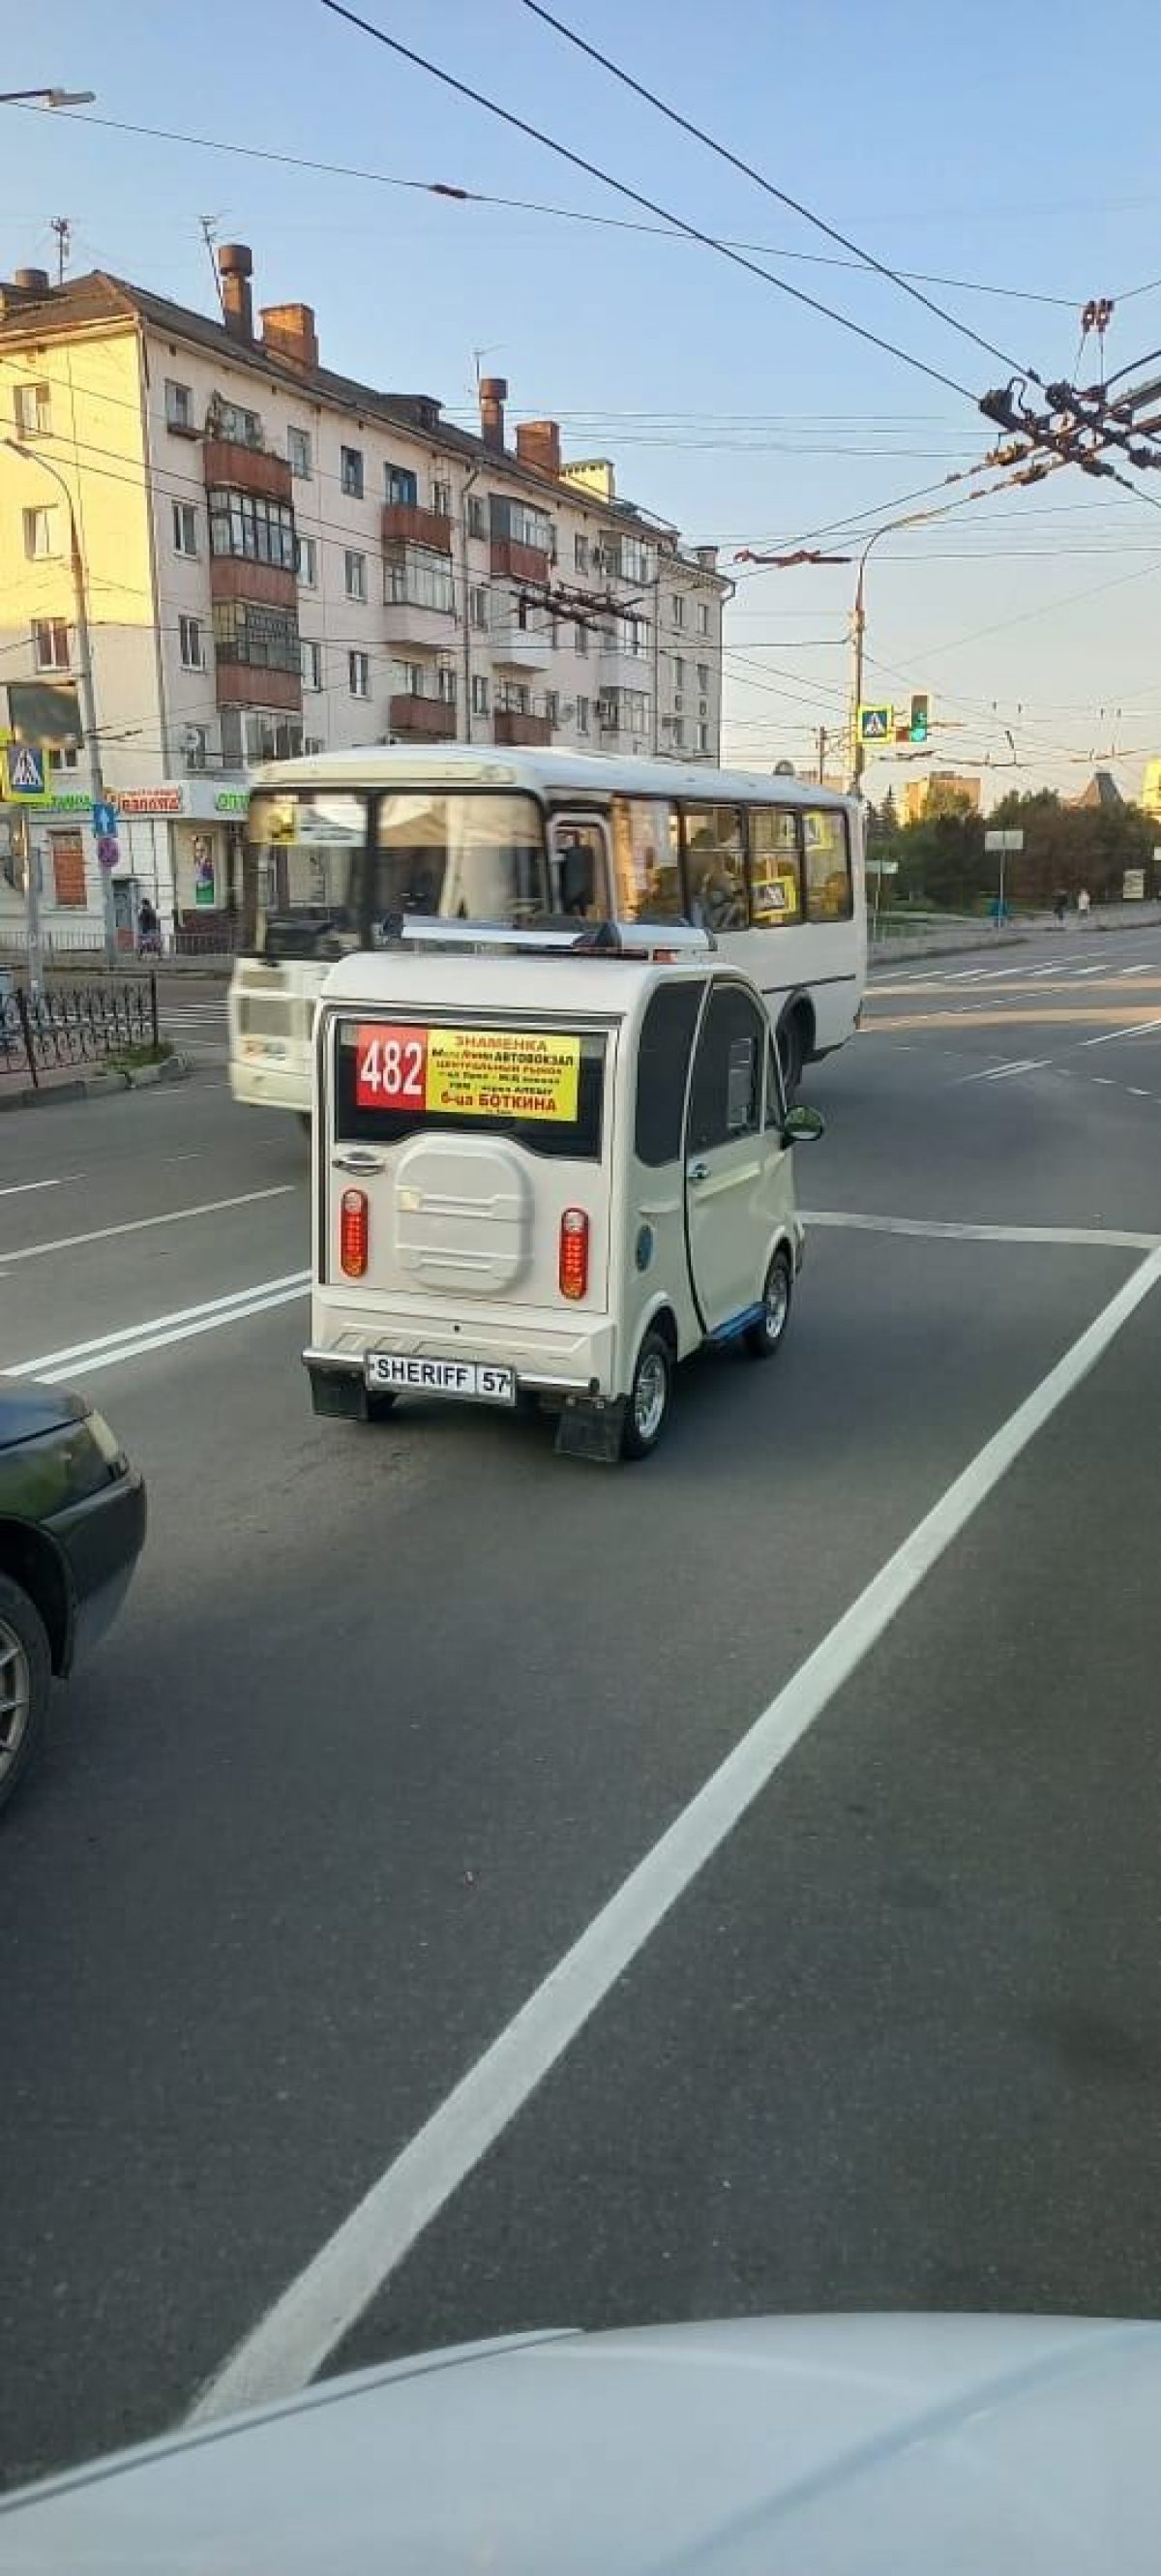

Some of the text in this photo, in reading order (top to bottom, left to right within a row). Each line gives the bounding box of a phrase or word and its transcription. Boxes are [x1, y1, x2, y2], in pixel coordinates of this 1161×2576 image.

[455, 1035, 548, 1052] ЗНАМЕНКА
[360, 1039, 423, 1095] 482
[494, 1051, 574, 1065] АВТОВОКЗАЛ
[478, 1093, 556, 1112] БОТКИНА
[377, 1359, 507, 1393] SHERIFF 57
